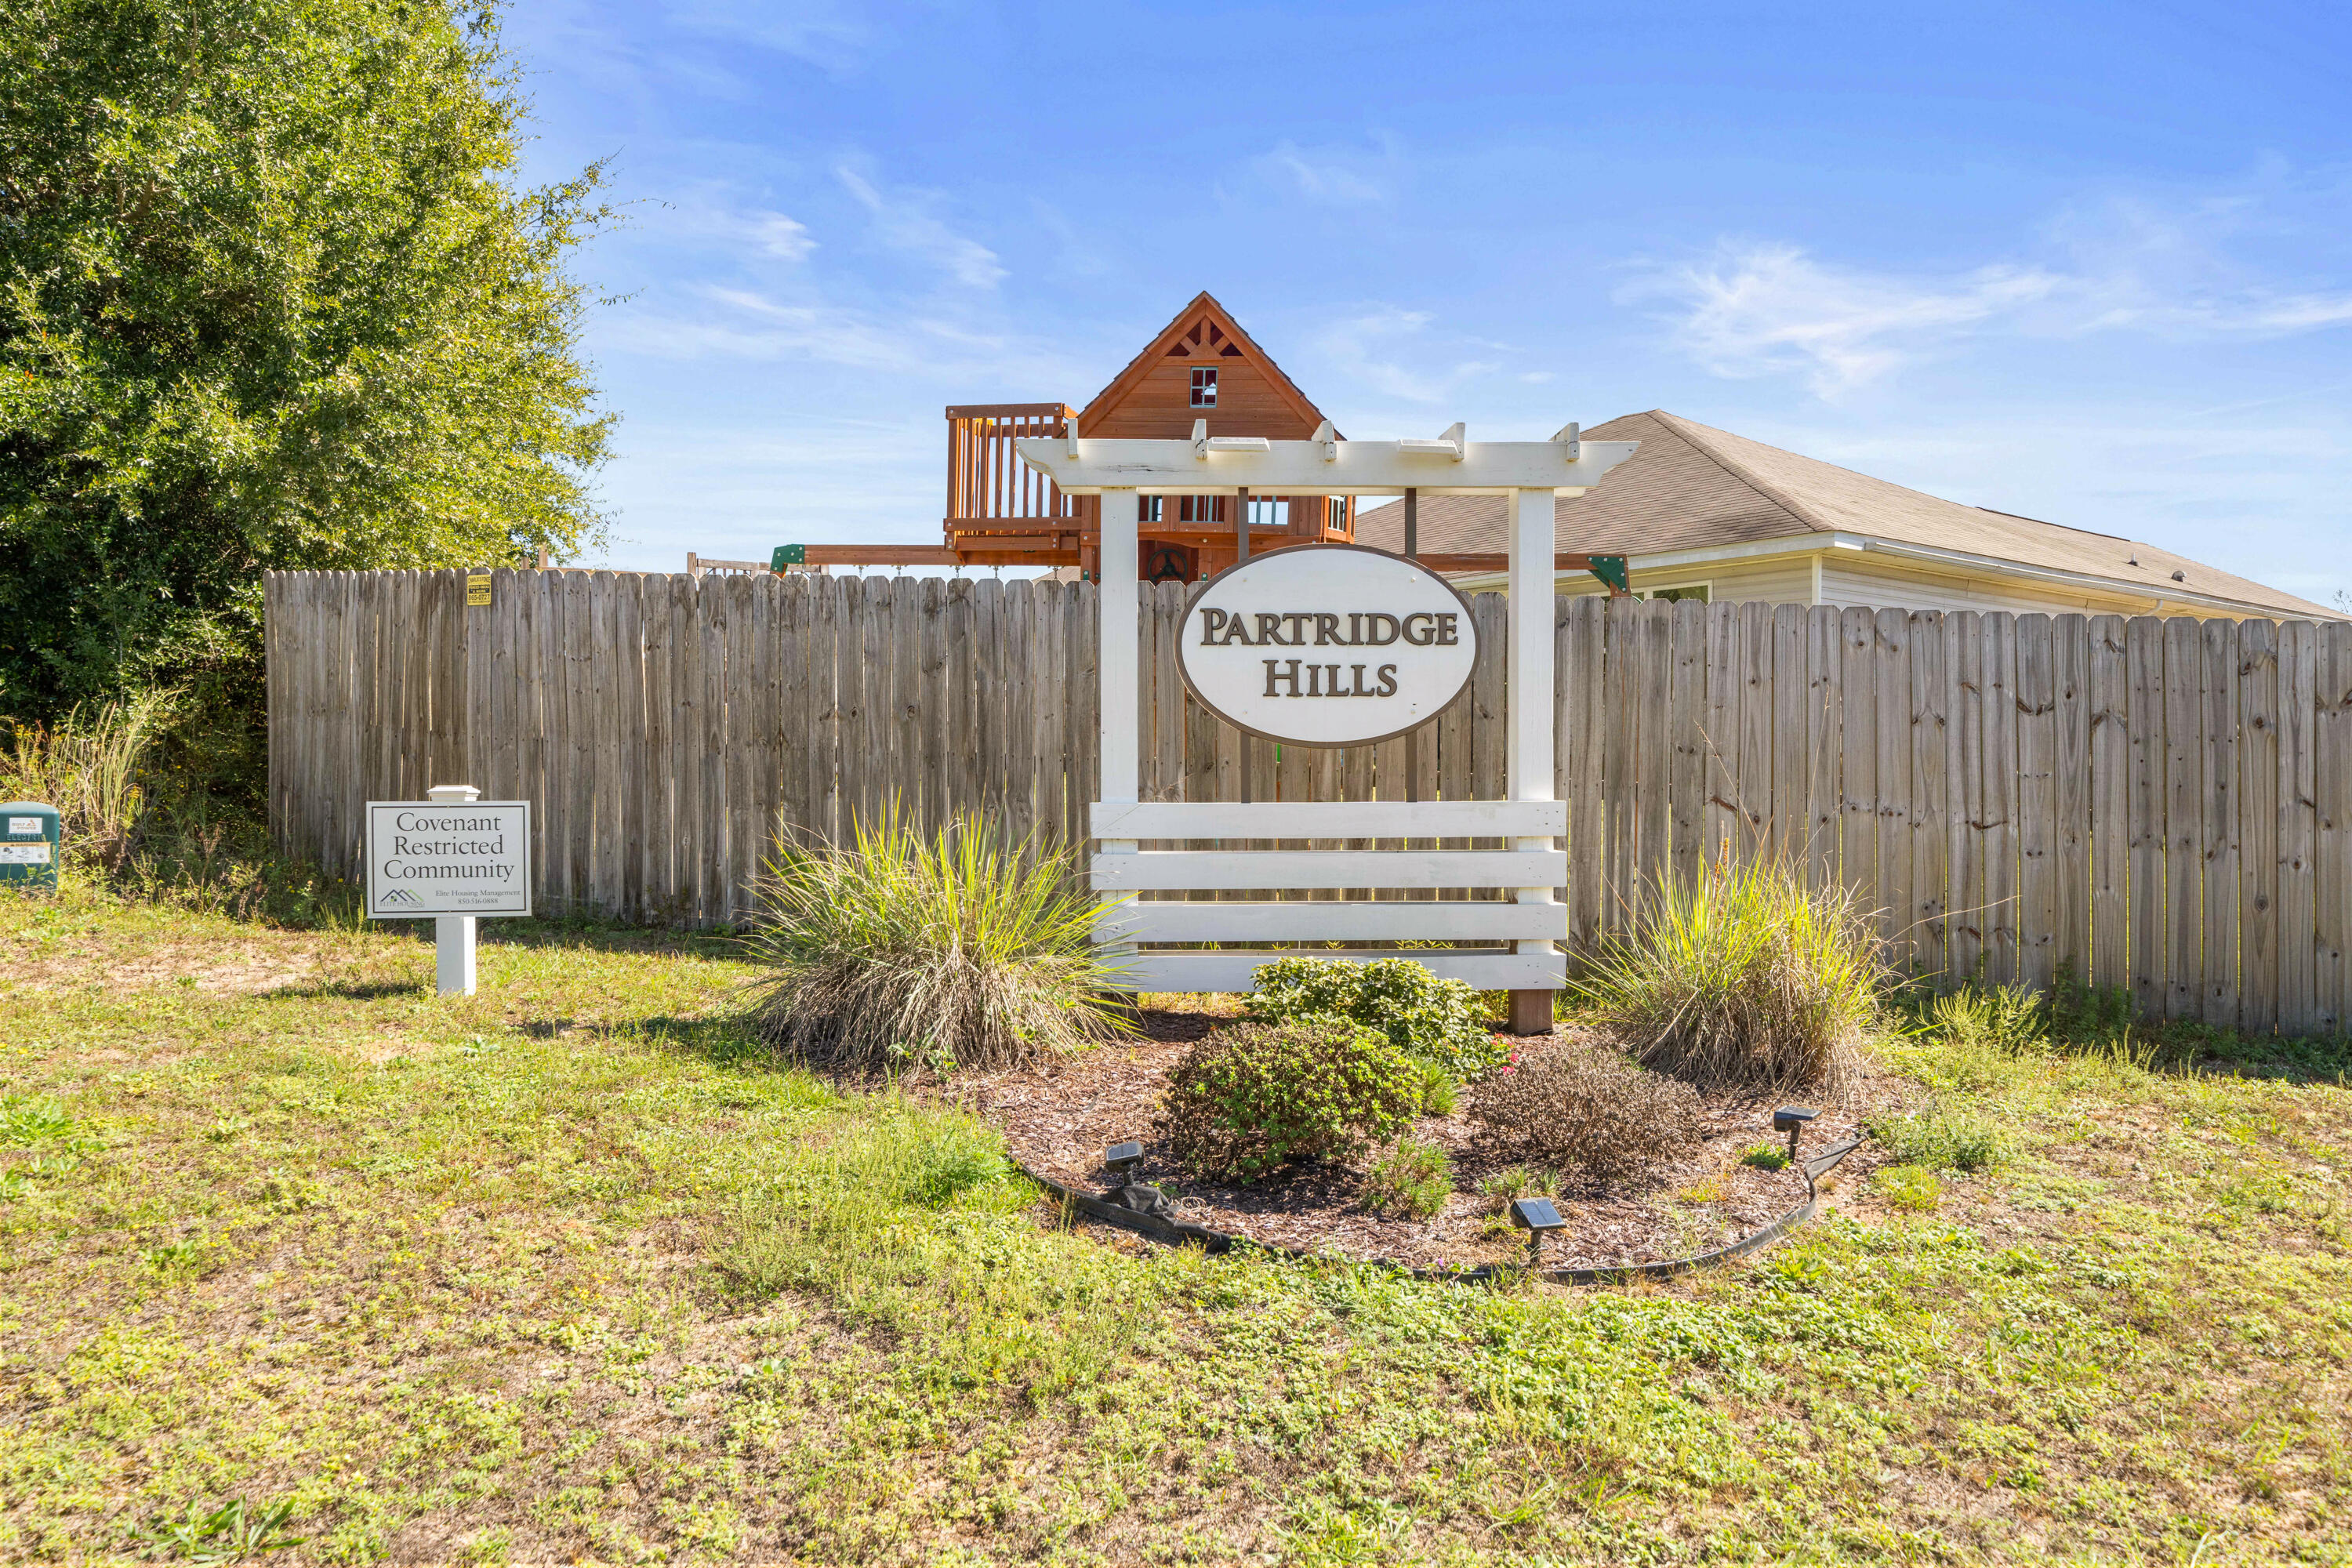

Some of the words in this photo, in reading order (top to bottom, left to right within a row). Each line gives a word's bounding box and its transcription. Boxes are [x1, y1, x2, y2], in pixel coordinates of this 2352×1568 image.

[1200, 608, 1459, 646] PARTRIDGE
[1261, 659, 1398, 697] HILLS
[397, 812, 502, 832] Covenant
[394, 834, 504, 855] Restricted
[384, 859, 514, 883] Community
